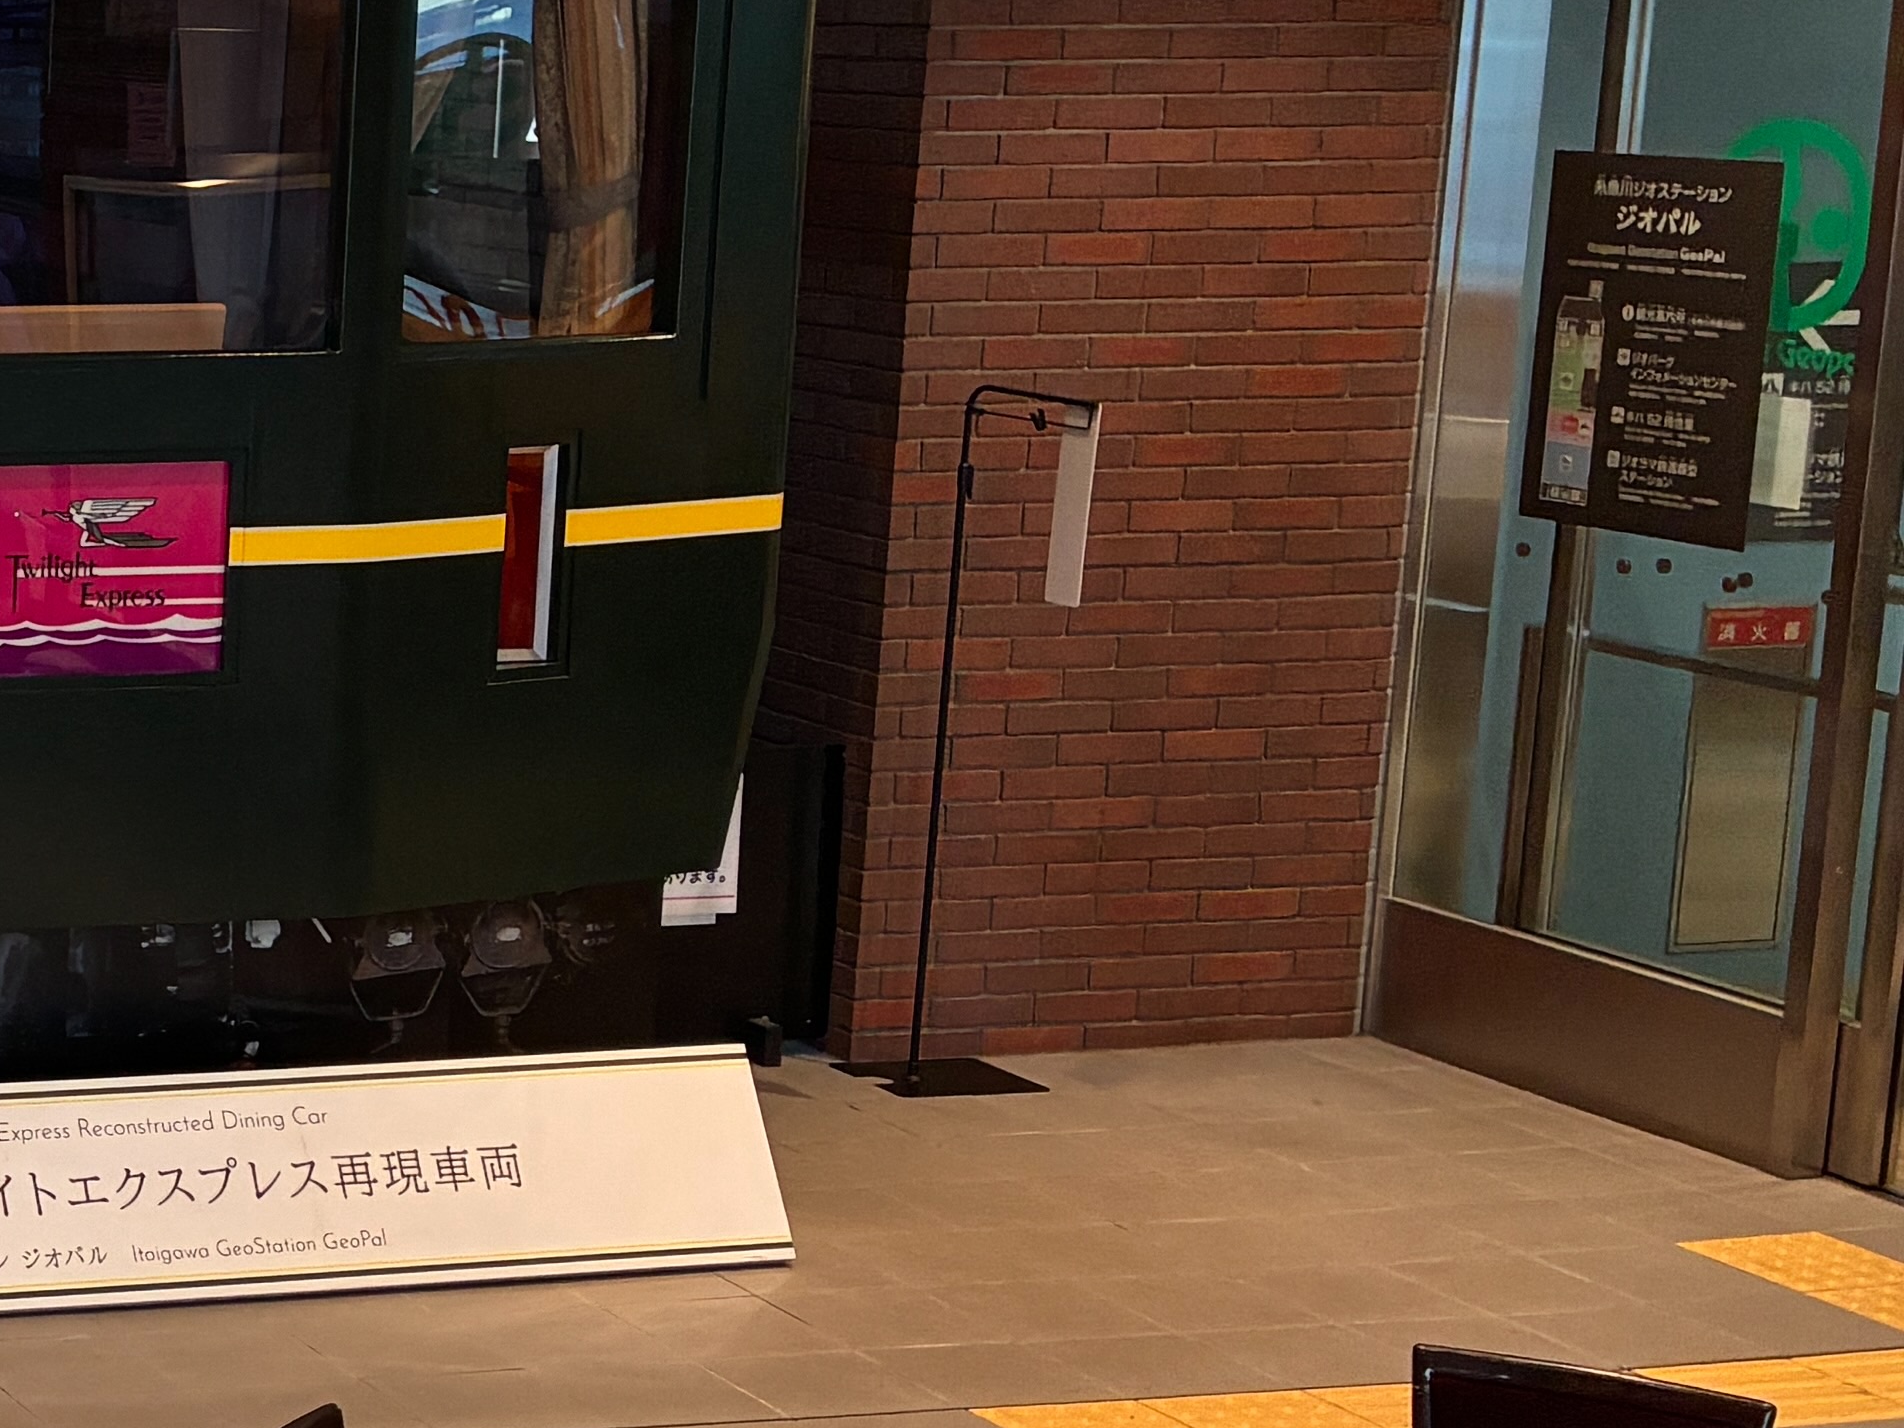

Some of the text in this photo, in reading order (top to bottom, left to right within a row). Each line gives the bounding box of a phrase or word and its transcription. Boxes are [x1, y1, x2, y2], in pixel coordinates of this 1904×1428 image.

[1615, 204, 1702, 236] ジオパル
[5, 553, 98, 613] Twilight
[79, 583, 167, 612] Express
[78, 1109, 214, 1138] Reconstructed
[222, 1106, 286, 1133] Dining
[292, 1104, 329, 1126] Car
[21, 1244, 109, 1270] ジオパル
[131, 1241, 209, 1264] Itoigawa
[216, 1234, 318, 1258] GeoStation
[322, 1228, 388, 1251] GeoPal
